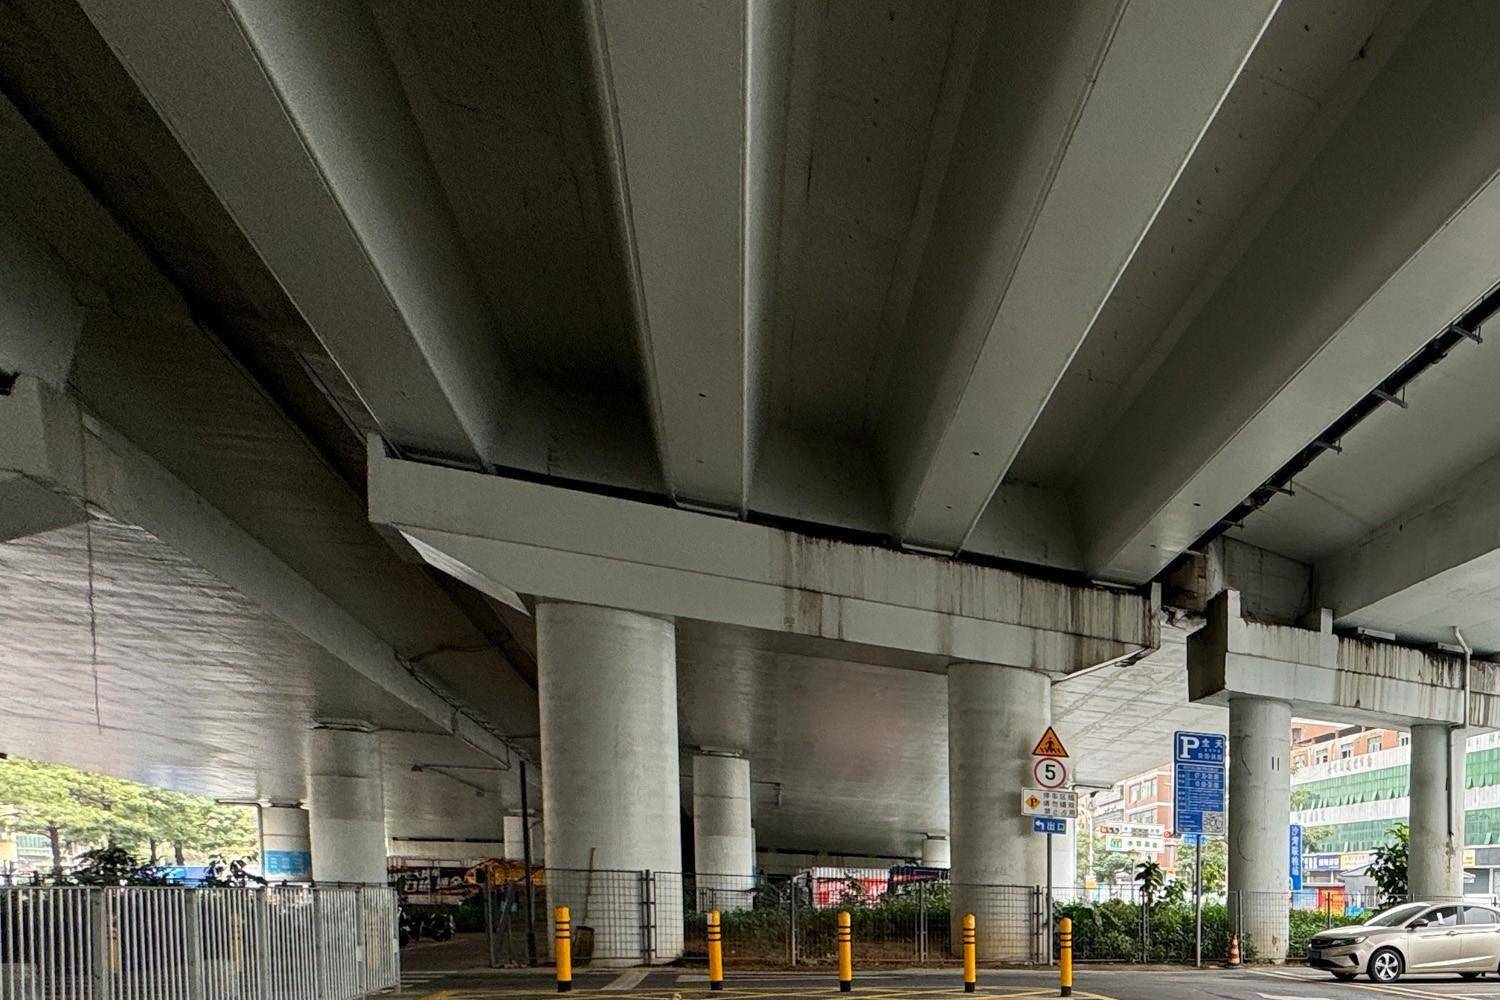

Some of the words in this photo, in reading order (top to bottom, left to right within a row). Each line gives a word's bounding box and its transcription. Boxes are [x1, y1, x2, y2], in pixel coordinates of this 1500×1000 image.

[1180, 736, 1199, 758] P
[1045, 764, 1056, 780] 5
[1047, 821, 1065, 831] 出口
